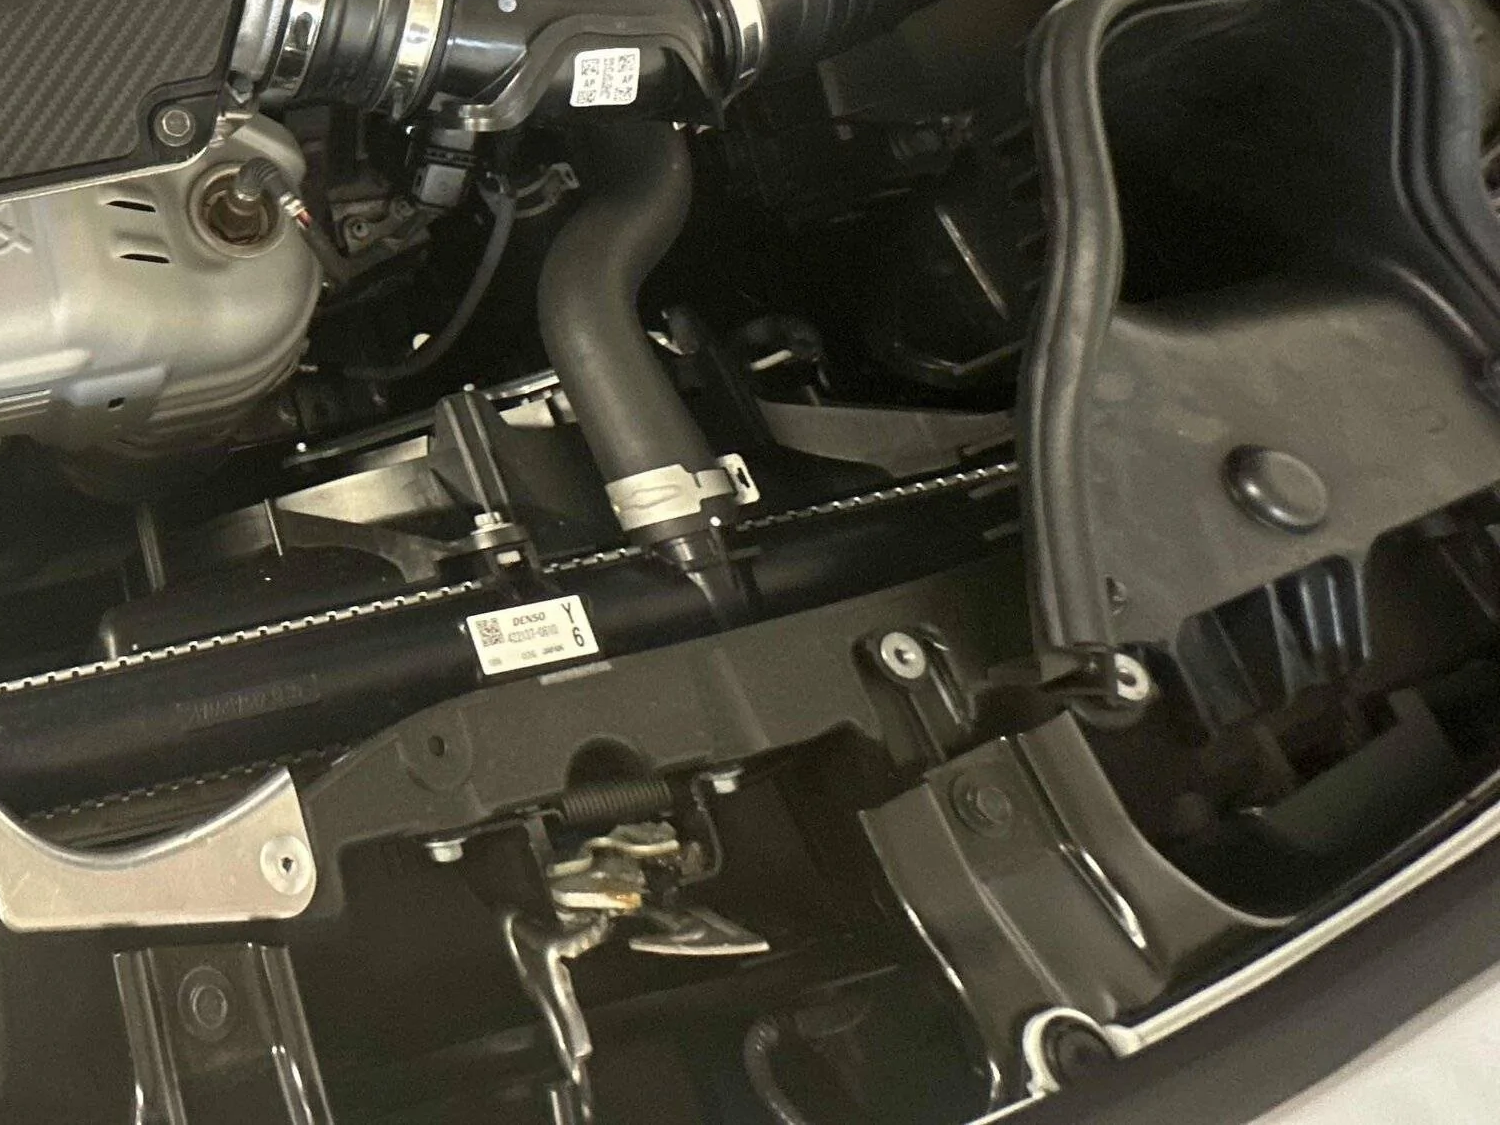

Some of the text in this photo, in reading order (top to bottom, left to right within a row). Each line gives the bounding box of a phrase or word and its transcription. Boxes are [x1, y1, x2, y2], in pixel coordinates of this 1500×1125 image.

[512, 602, 575, 627] DENSO Y
[572, 626, 585, 648] 6
